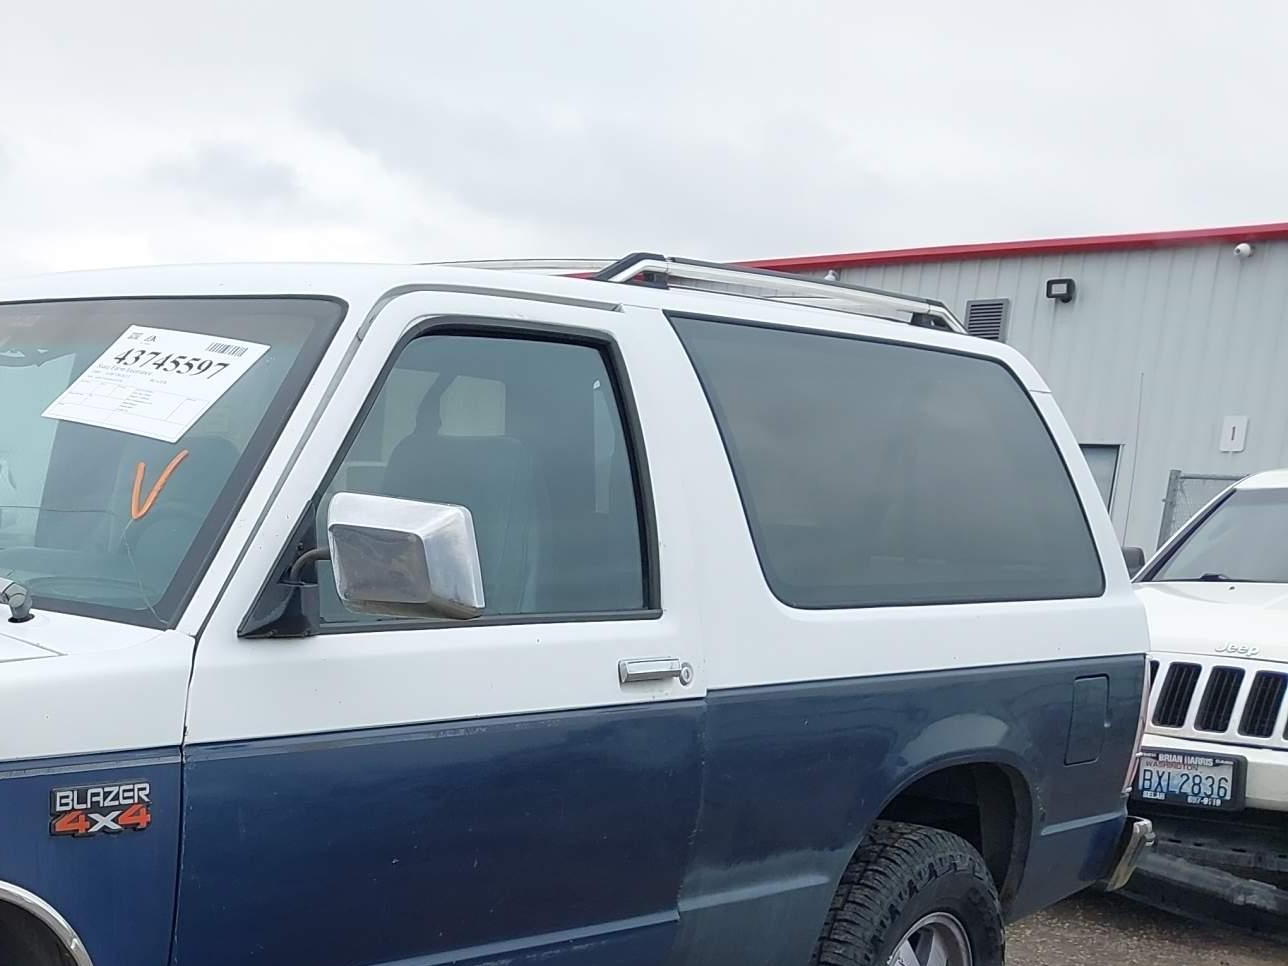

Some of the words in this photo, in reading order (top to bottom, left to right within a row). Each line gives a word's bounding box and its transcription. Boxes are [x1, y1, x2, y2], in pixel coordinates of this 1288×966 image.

[114, 348, 231, 380] 43745597
[1214, 640, 1260, 657] Jeep
[1158, 754, 1183, 764] BRIAN
[1184, 756, 1214, 767] HARRIS
[56, 783, 151, 811] BLAZER
[1143, 769, 1229, 799] BXL2836
